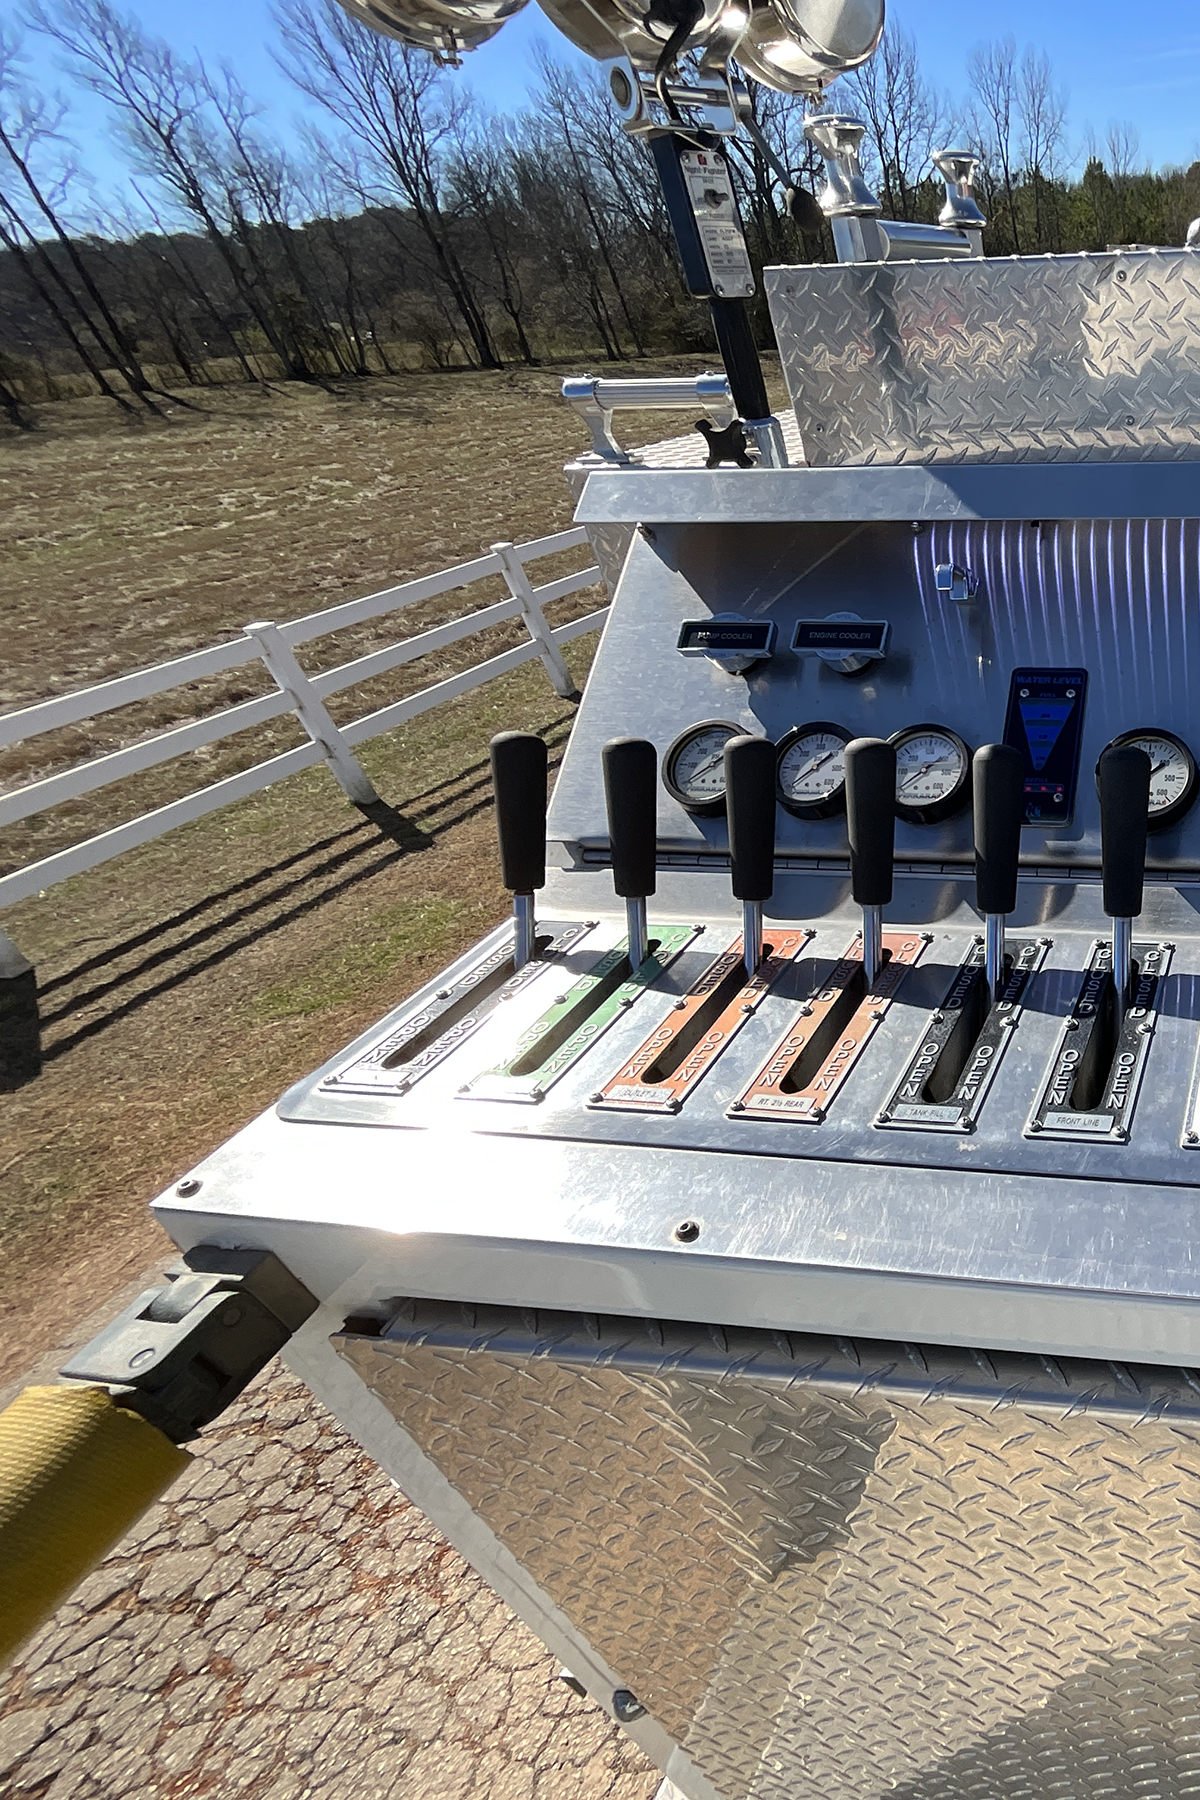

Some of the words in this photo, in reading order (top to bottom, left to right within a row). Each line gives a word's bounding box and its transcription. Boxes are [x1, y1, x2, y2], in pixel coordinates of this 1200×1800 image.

[697, 632, 720, 640] PUMP
[721, 632, 753, 640] COOLER
[1017, 676, 1052, 684] WATER
[1052, 676, 1084, 685] LEVEL
[1156, 788, 1168, 796] 600
[1164, 774, 1176, 782] 500
[693, 941, 744, 996] LOSED
[867, 941, 917, 1005] CLOSED
[997, 946, 1037, 1012] CLOSED
[1079, 948, 1113, 1015] CLOSED
[1130, 950, 1161, 1020] CLOSED
[361, 1014, 431, 1065] OPEN
[412, 1016, 477, 1067] OPEN
[542, 1022, 599, 1075] OPEN
[621, 1028, 674, 1080] OPEN
[674, 1030, 726, 1084] OPEN
[759, 1035, 806, 1089] OPEN
[813, 1039, 858, 1092] OPEN
[900, 1042, 940, 1098] OPEN
[957, 1045, 995, 1101] OPEN
[1047, 1049, 1080, 1106] OPEN
[1107, 1052, 1137, 1110] OPEN
[757, 1098, 769, 1106] RT.
[783, 1100, 805, 1108] REAR
[910, 1108, 929, 1116] TANK
[930, 1109, 944, 1118] FILL
[1056, 1116, 1082, 1125] FRONT
[1083, 1119, 1100, 1127] LINE
